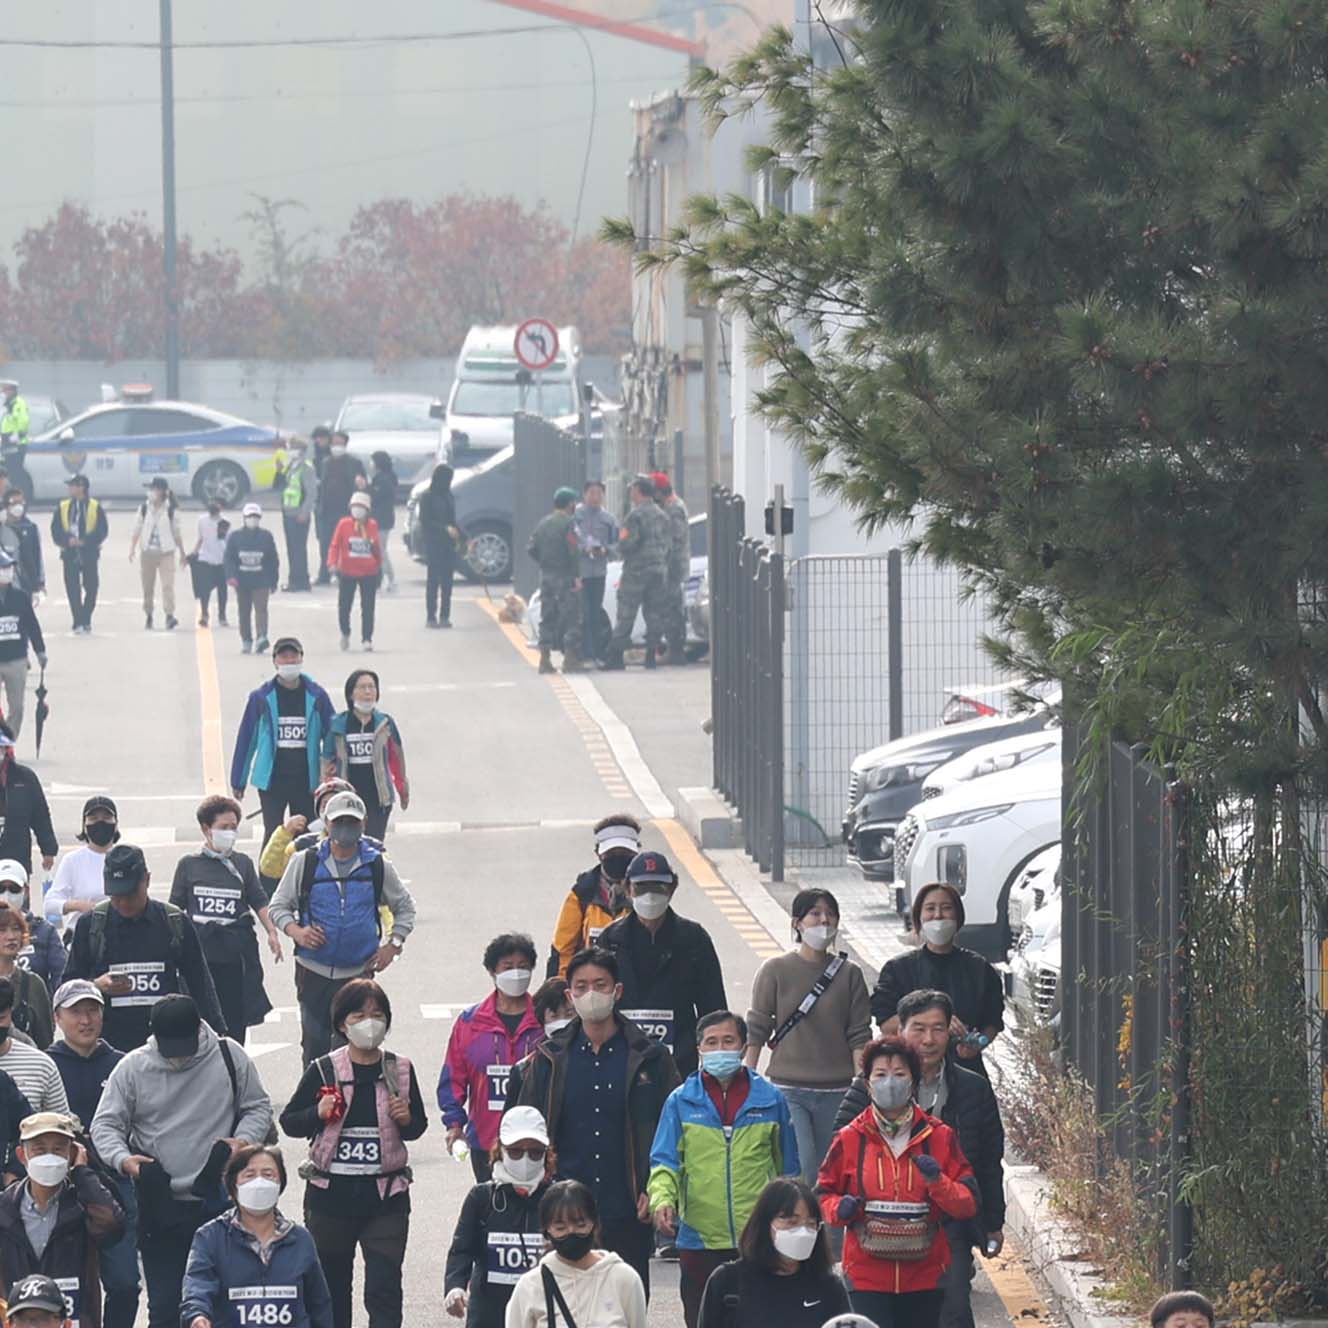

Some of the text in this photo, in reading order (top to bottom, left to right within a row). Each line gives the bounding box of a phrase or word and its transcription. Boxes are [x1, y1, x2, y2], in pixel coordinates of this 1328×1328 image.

[197, 897, 236, 915] 1254
[338, 1142, 379, 1161] 343
[236, 1303, 293, 1325] 1486
